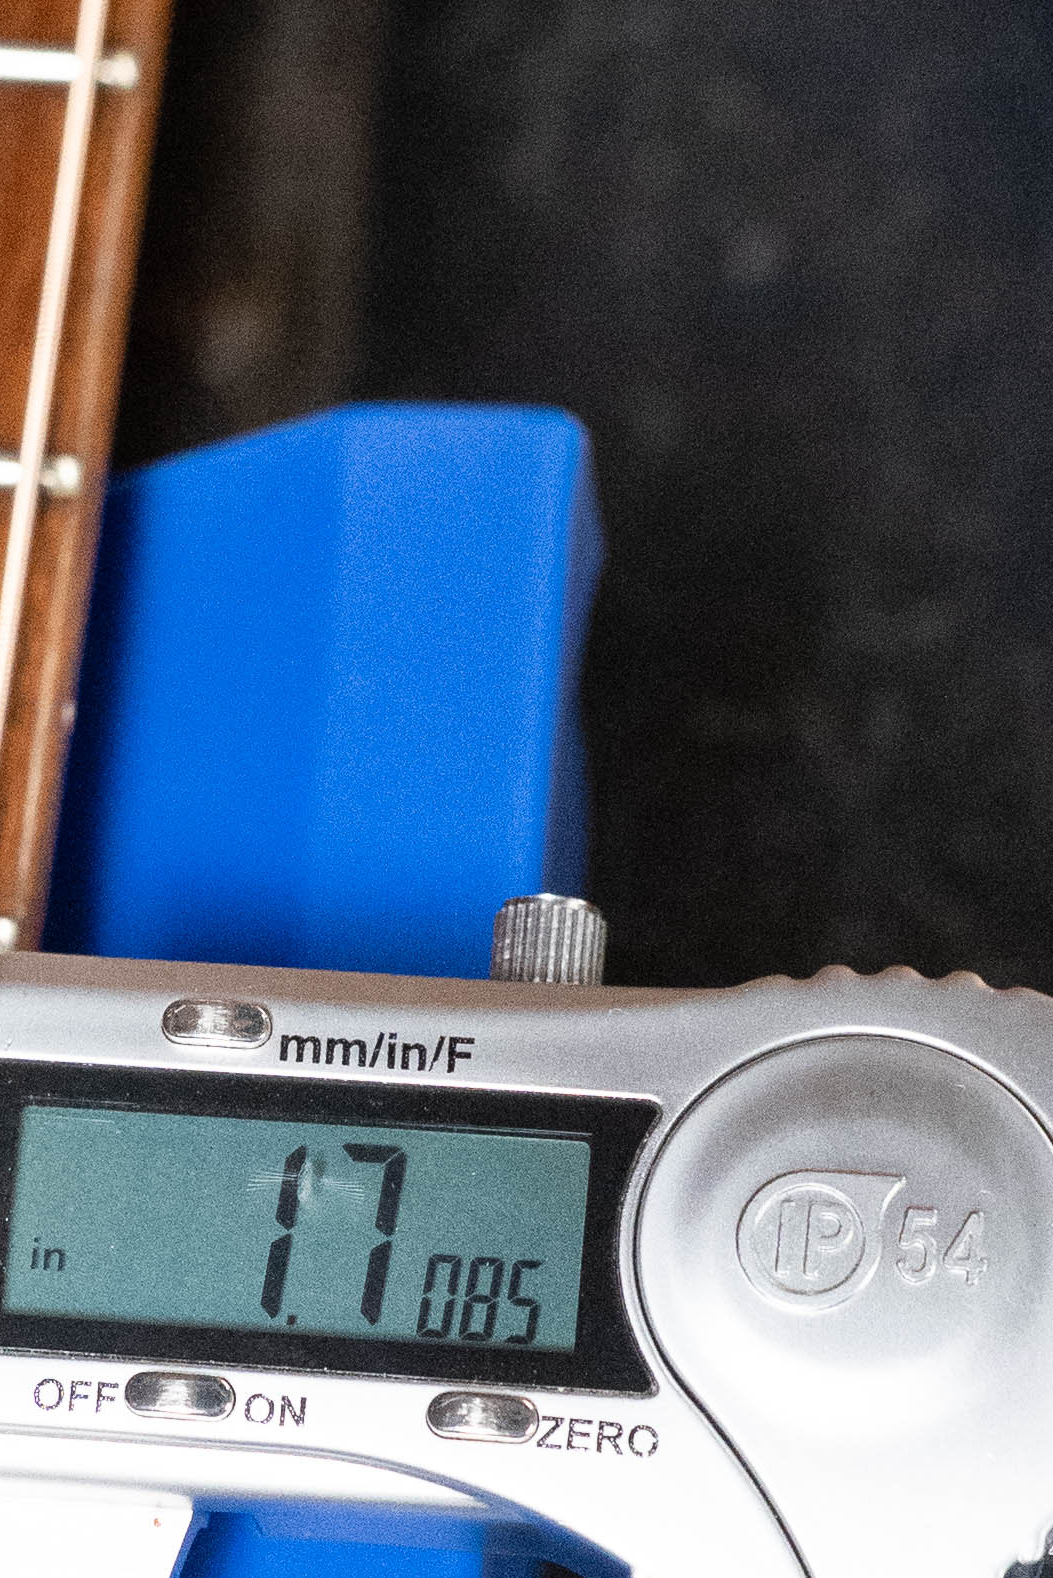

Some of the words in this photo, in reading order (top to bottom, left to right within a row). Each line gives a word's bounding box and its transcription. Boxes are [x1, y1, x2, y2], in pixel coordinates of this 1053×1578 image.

[279, 1031, 475, 1074] mm/in/F
[30, 1238, 66, 1272] in
[895, 1205, 989, 1287] 54
[33, 1378, 119, 1414] OFF
[243, 1393, 308, 1428] ON
[536, 1416, 659, 1459] ZERO
